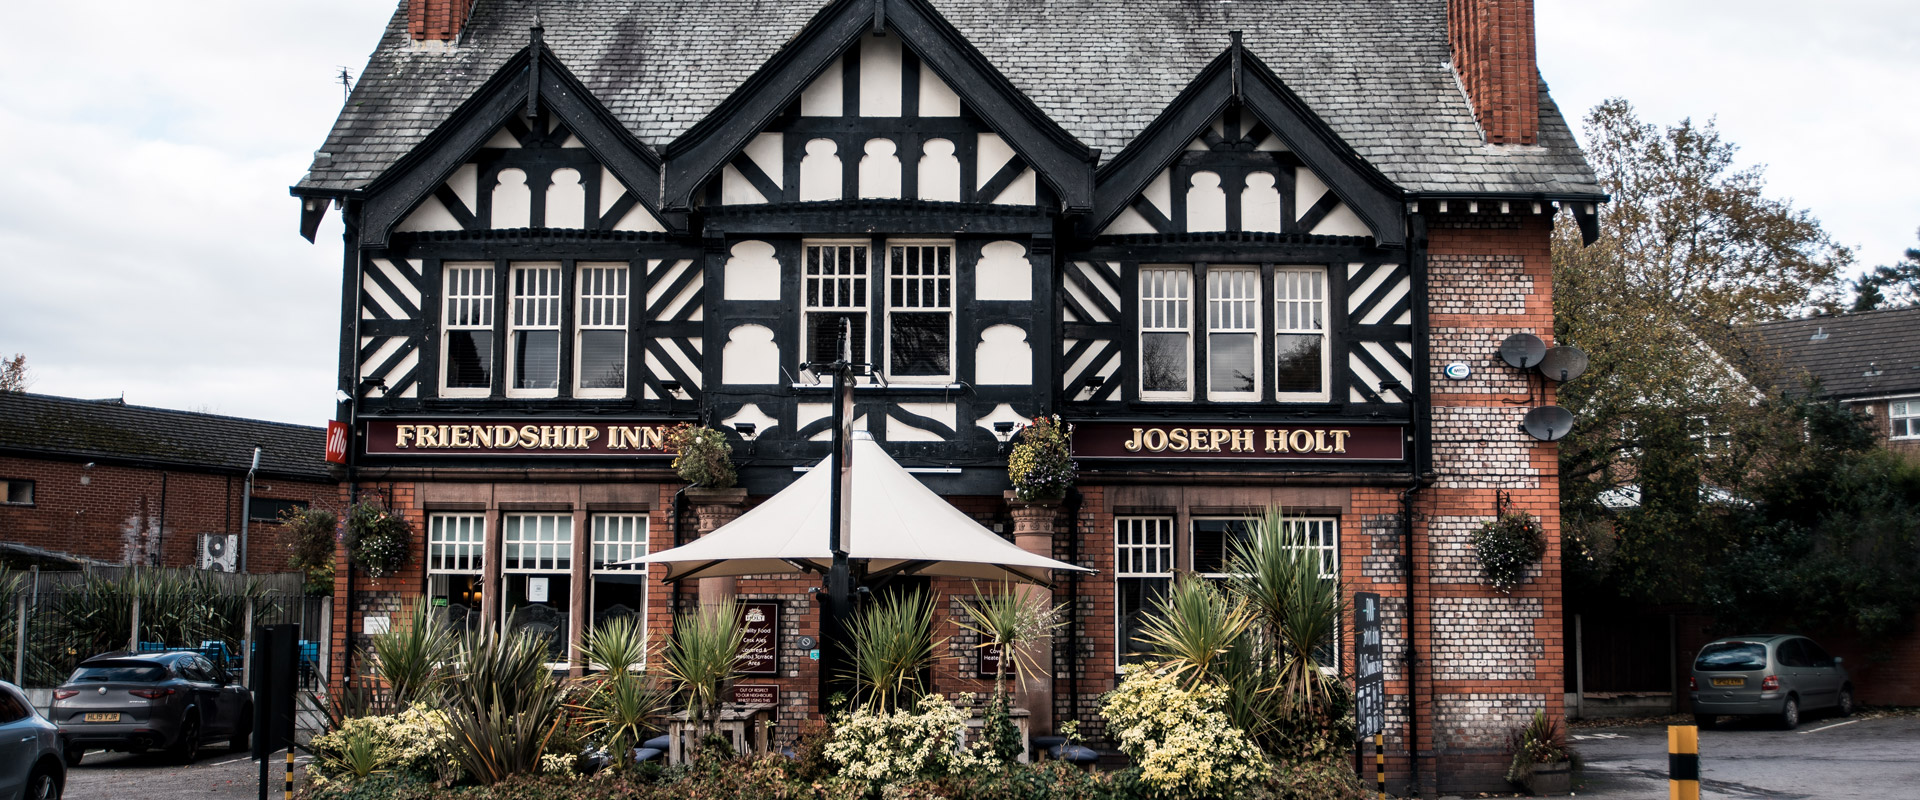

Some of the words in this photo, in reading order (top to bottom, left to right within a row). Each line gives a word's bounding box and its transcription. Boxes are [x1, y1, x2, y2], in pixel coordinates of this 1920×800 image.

[329, 427, 347, 460] illy
[395, 424, 600, 449] FRIENDSHIP
[606, 425, 664, 450] INN
[1124, 427, 1256, 453] JOSEPH
[1264, 429, 1351, 454] HOLT
